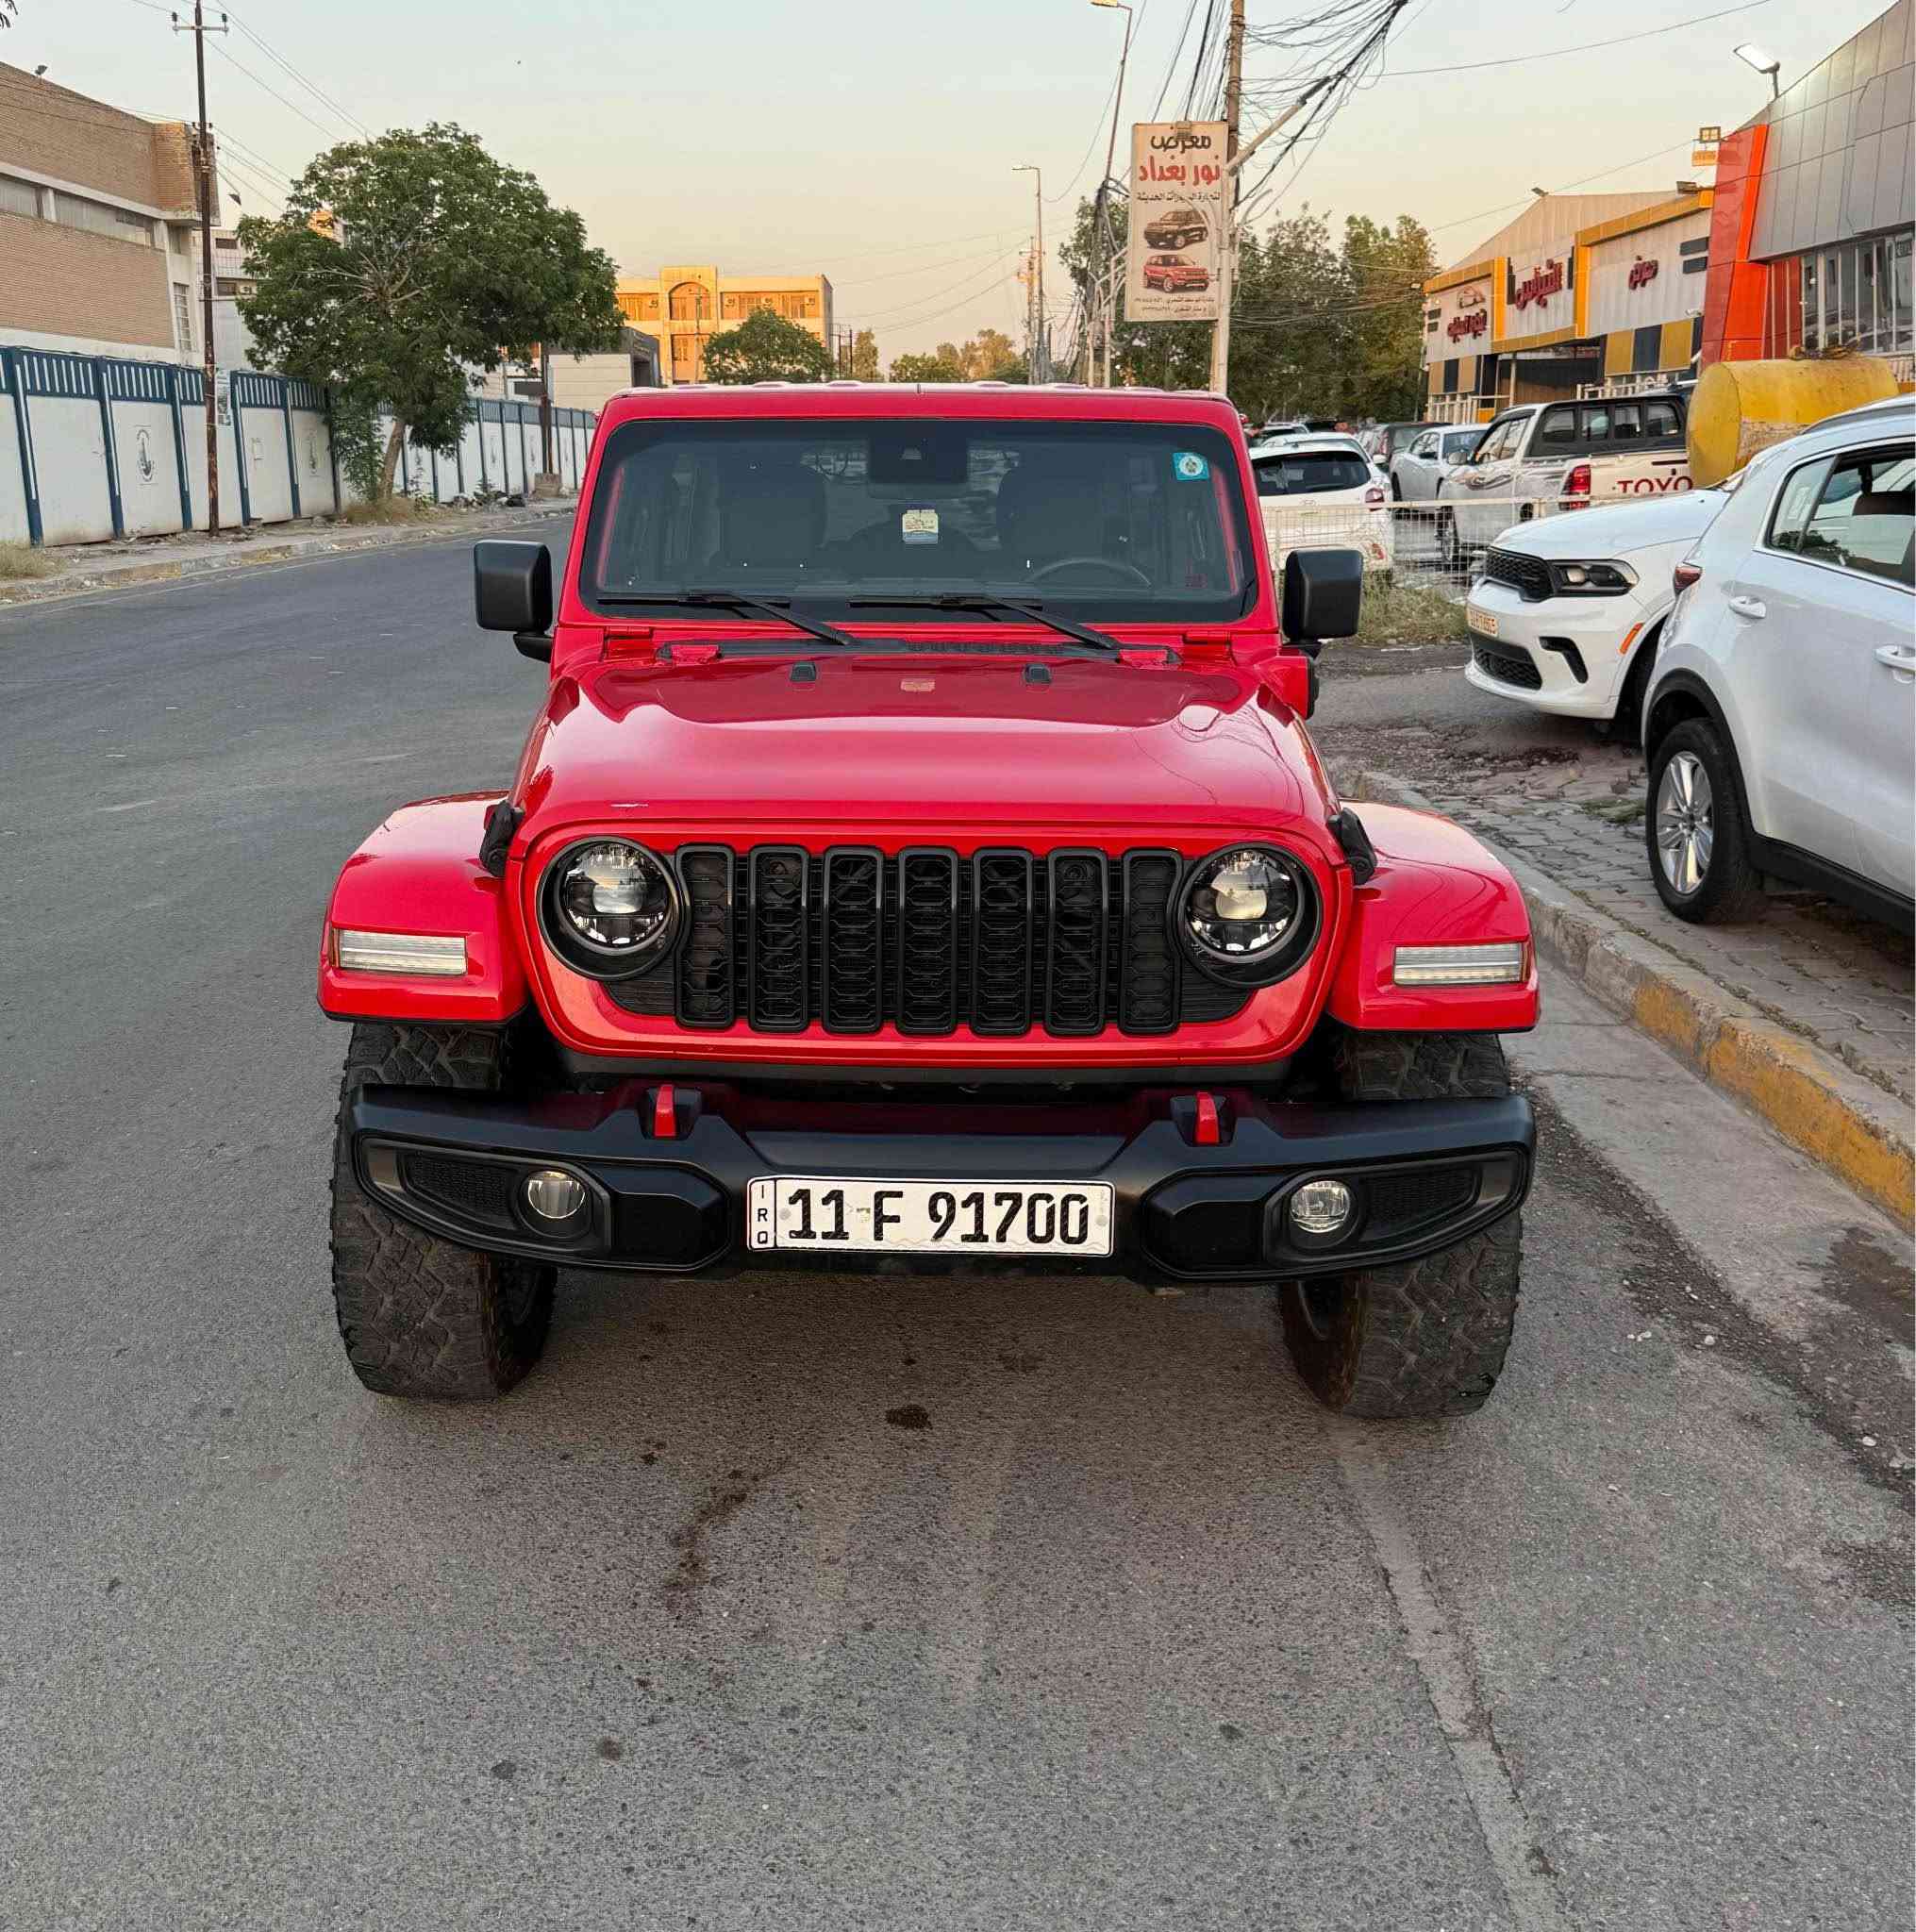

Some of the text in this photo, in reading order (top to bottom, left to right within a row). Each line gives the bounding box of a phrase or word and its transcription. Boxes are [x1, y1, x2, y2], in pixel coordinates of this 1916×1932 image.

[1150, 125, 1211, 154] معرض
[1139, 155, 1221, 187] نور بغداد
[788, 1189, 1089, 1245] 11 F 91700
